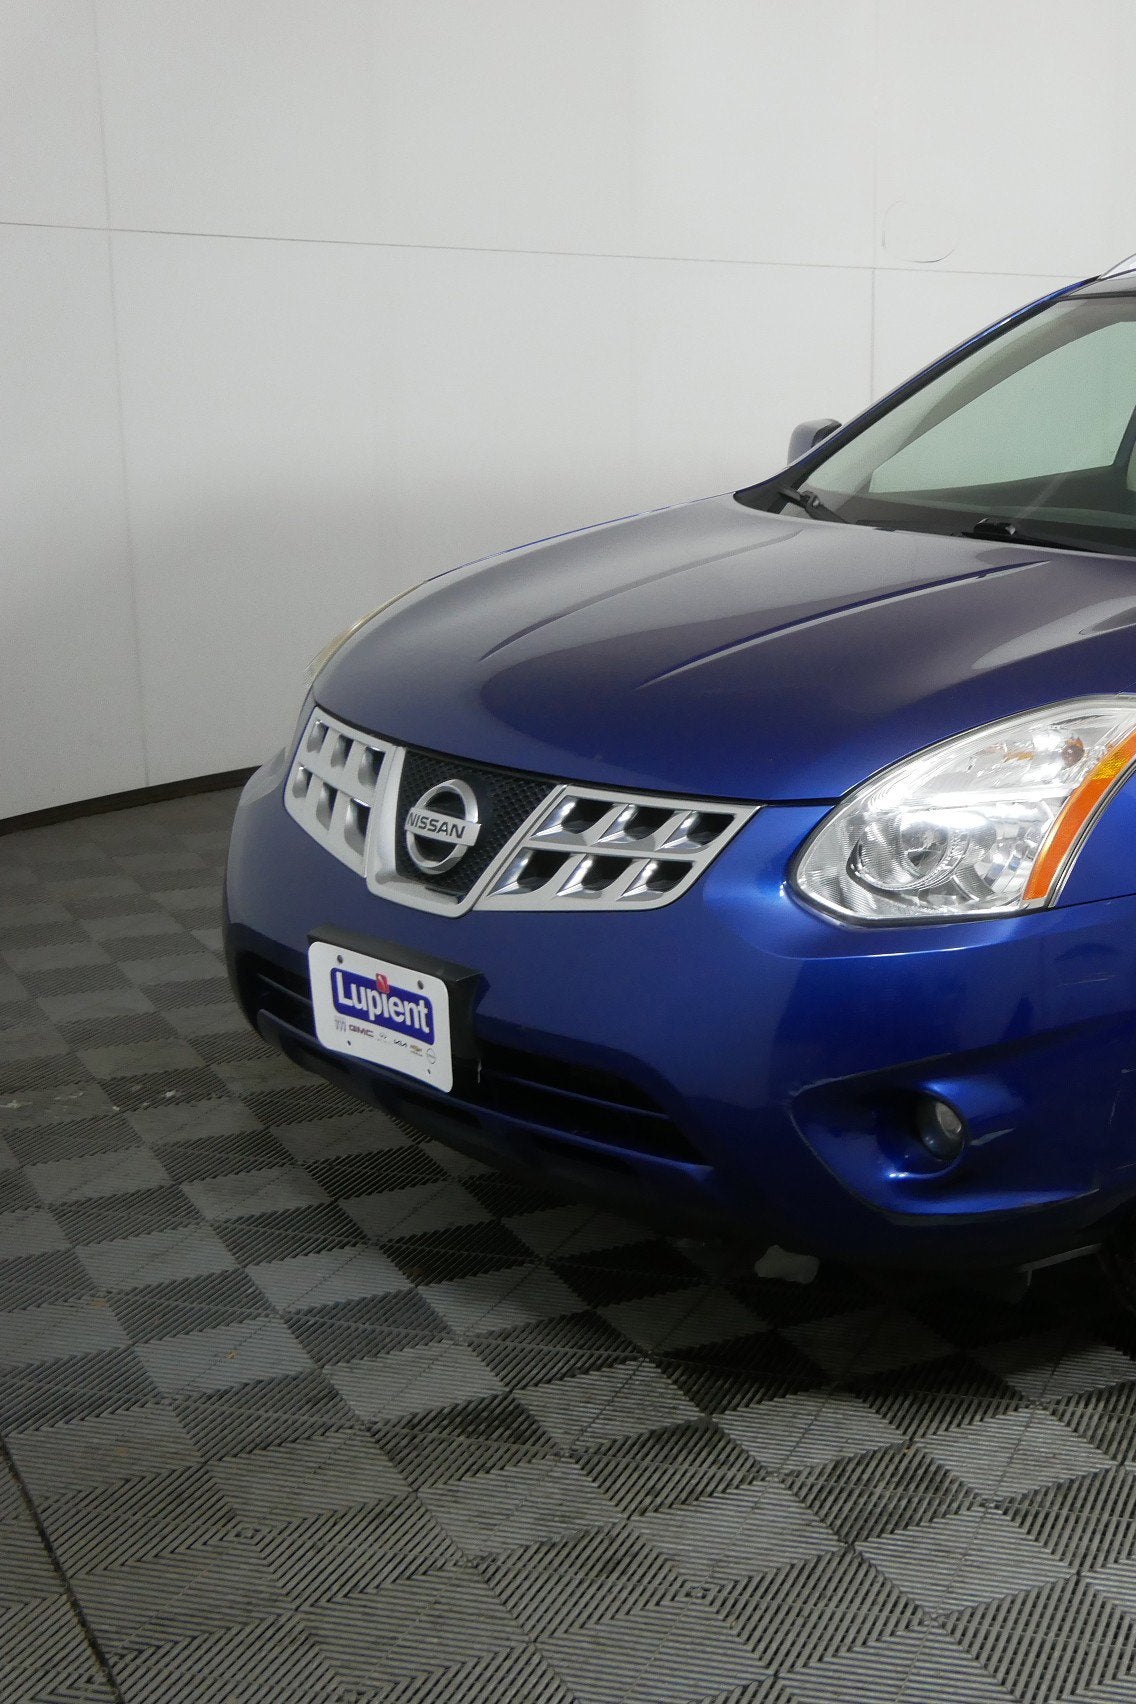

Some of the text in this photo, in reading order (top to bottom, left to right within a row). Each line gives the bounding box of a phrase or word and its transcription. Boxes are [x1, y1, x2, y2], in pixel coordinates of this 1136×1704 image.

[406, 811, 466, 839] NISSAN
[335, 972, 430, 1033] Lupient
[348, 1024, 374, 1037] GMC
